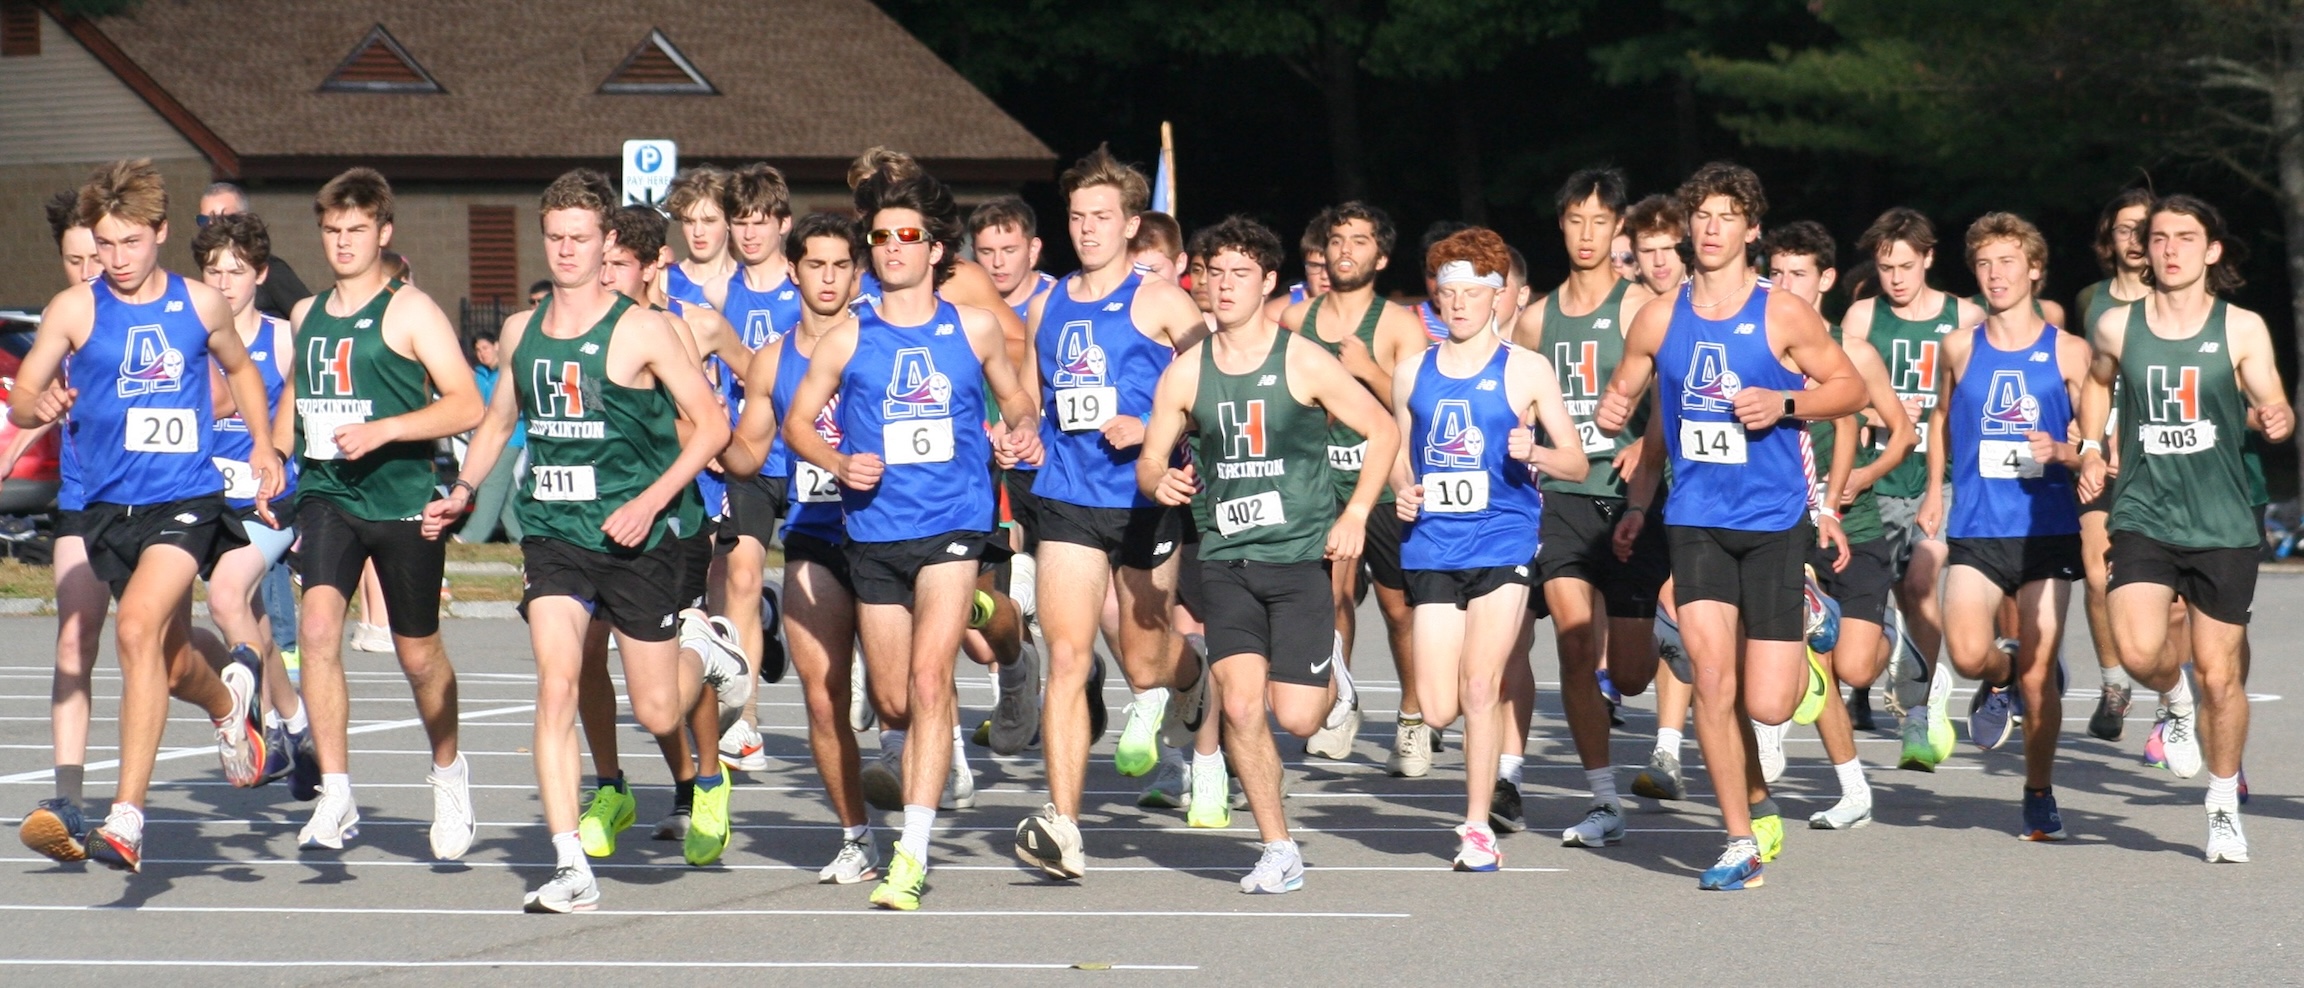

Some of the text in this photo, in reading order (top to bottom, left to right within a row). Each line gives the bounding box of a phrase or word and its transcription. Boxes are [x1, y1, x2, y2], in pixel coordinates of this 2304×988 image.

[641, 147, 660, 171] P
[627, 175, 669, 187] PAY HERE
[307, 336, 354, 396] H
[1555, 340, 1598, 397] H
[1891, 338, 1939, 392] H
[533, 358, 585, 418] H
[2147, 365, 2200, 423] H
[1067, 394, 1100, 424] 19
[143, 416, 184, 445] 20
[912, 427, 931, 456] 6
[1218, 399, 1266, 460] H
[1693, 429, 1730, 456] 14
[2158, 427, 2198, 449] 403
[1330, 448, 1362, 465] 441
[2003, 449, 2020, 472] 4
[541, 469, 574, 493] 411
[1438, 479, 1473, 506] 10
[1227, 498, 1265, 526] 402
